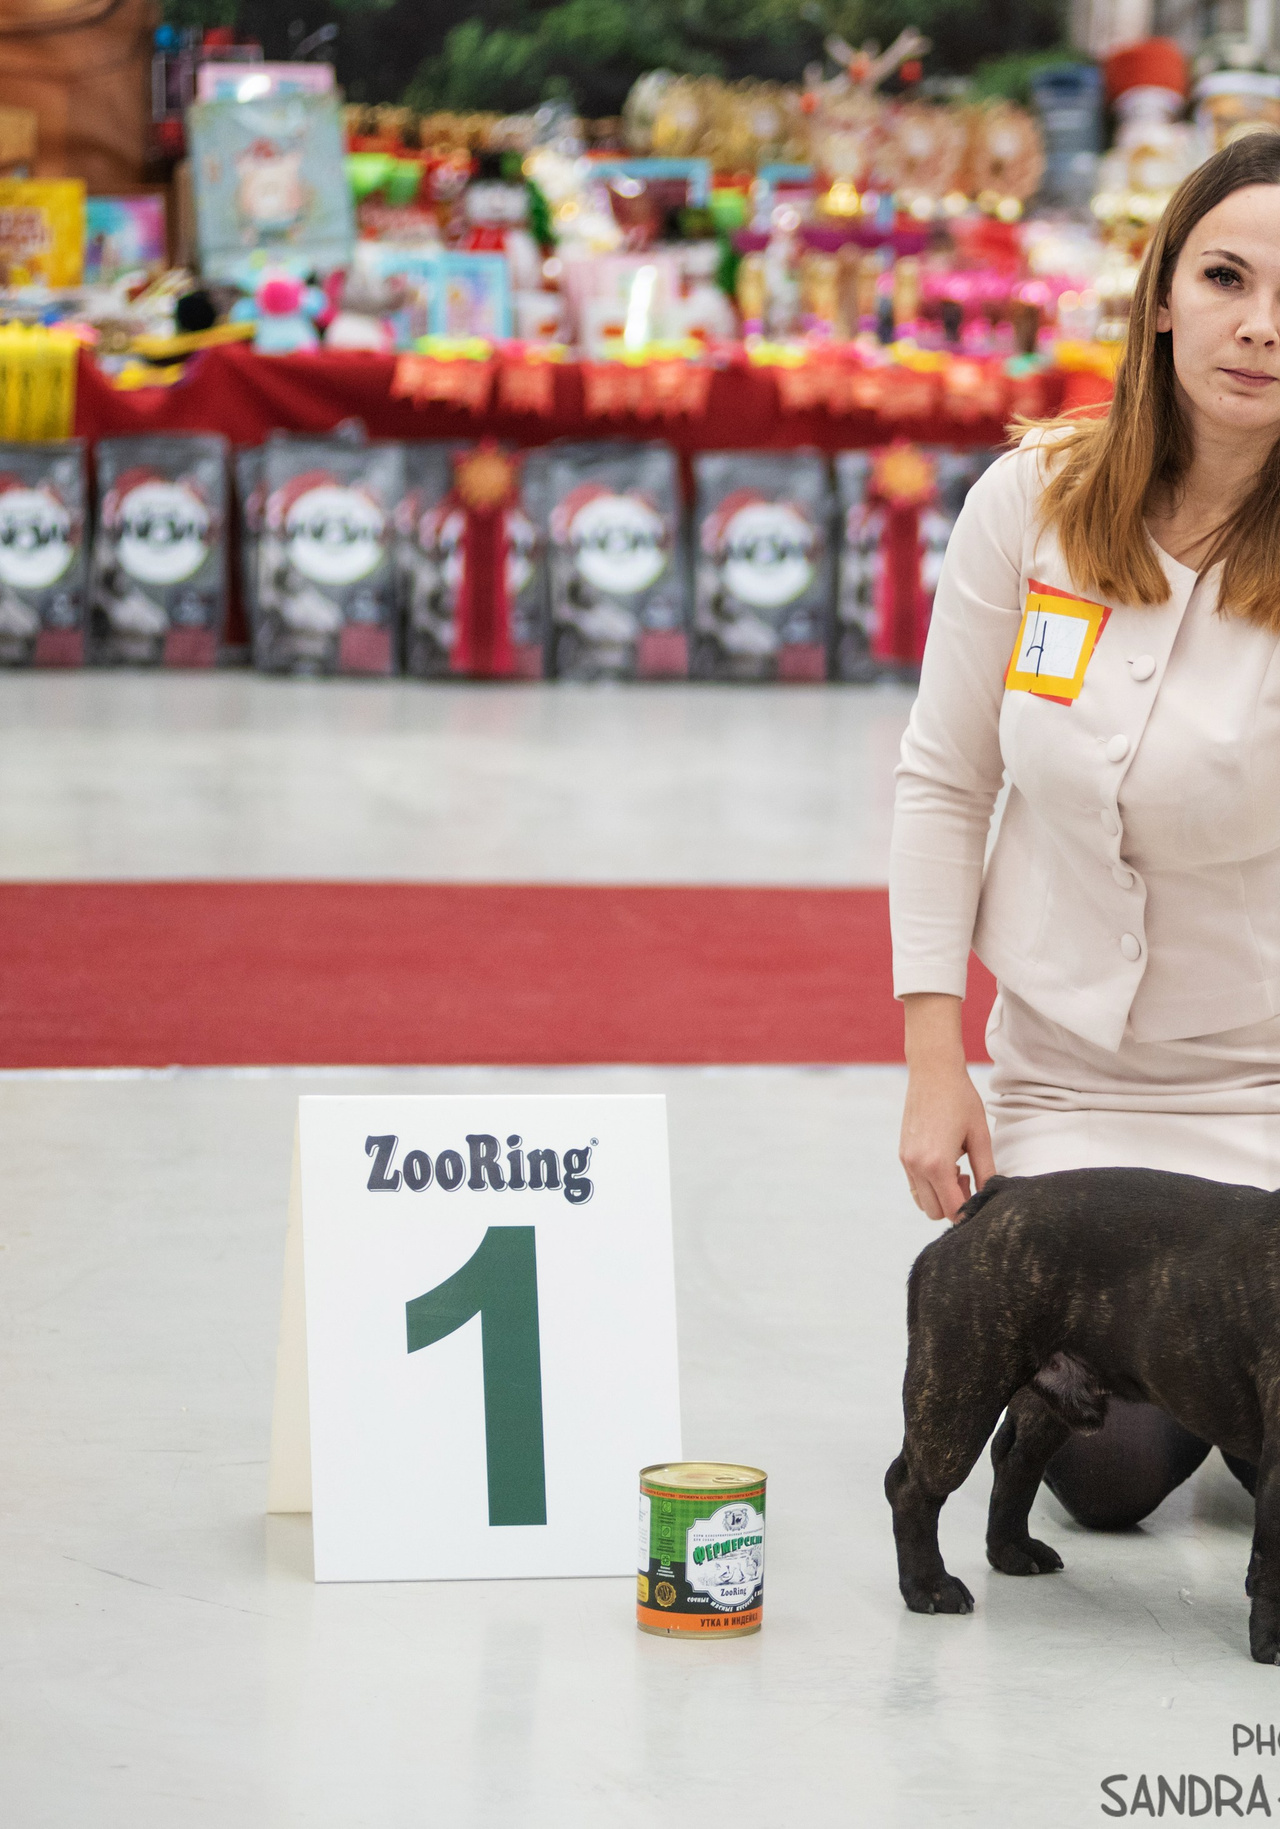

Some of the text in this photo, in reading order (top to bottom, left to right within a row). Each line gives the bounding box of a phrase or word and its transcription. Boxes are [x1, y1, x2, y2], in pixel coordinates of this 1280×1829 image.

[365, 1133, 596, 1205] ZooRing
[405, 1225, 547, 1526] 1
[720, 1587, 747, 1597] ZooRing
[700, 1618, 721, 1628] УТКА
